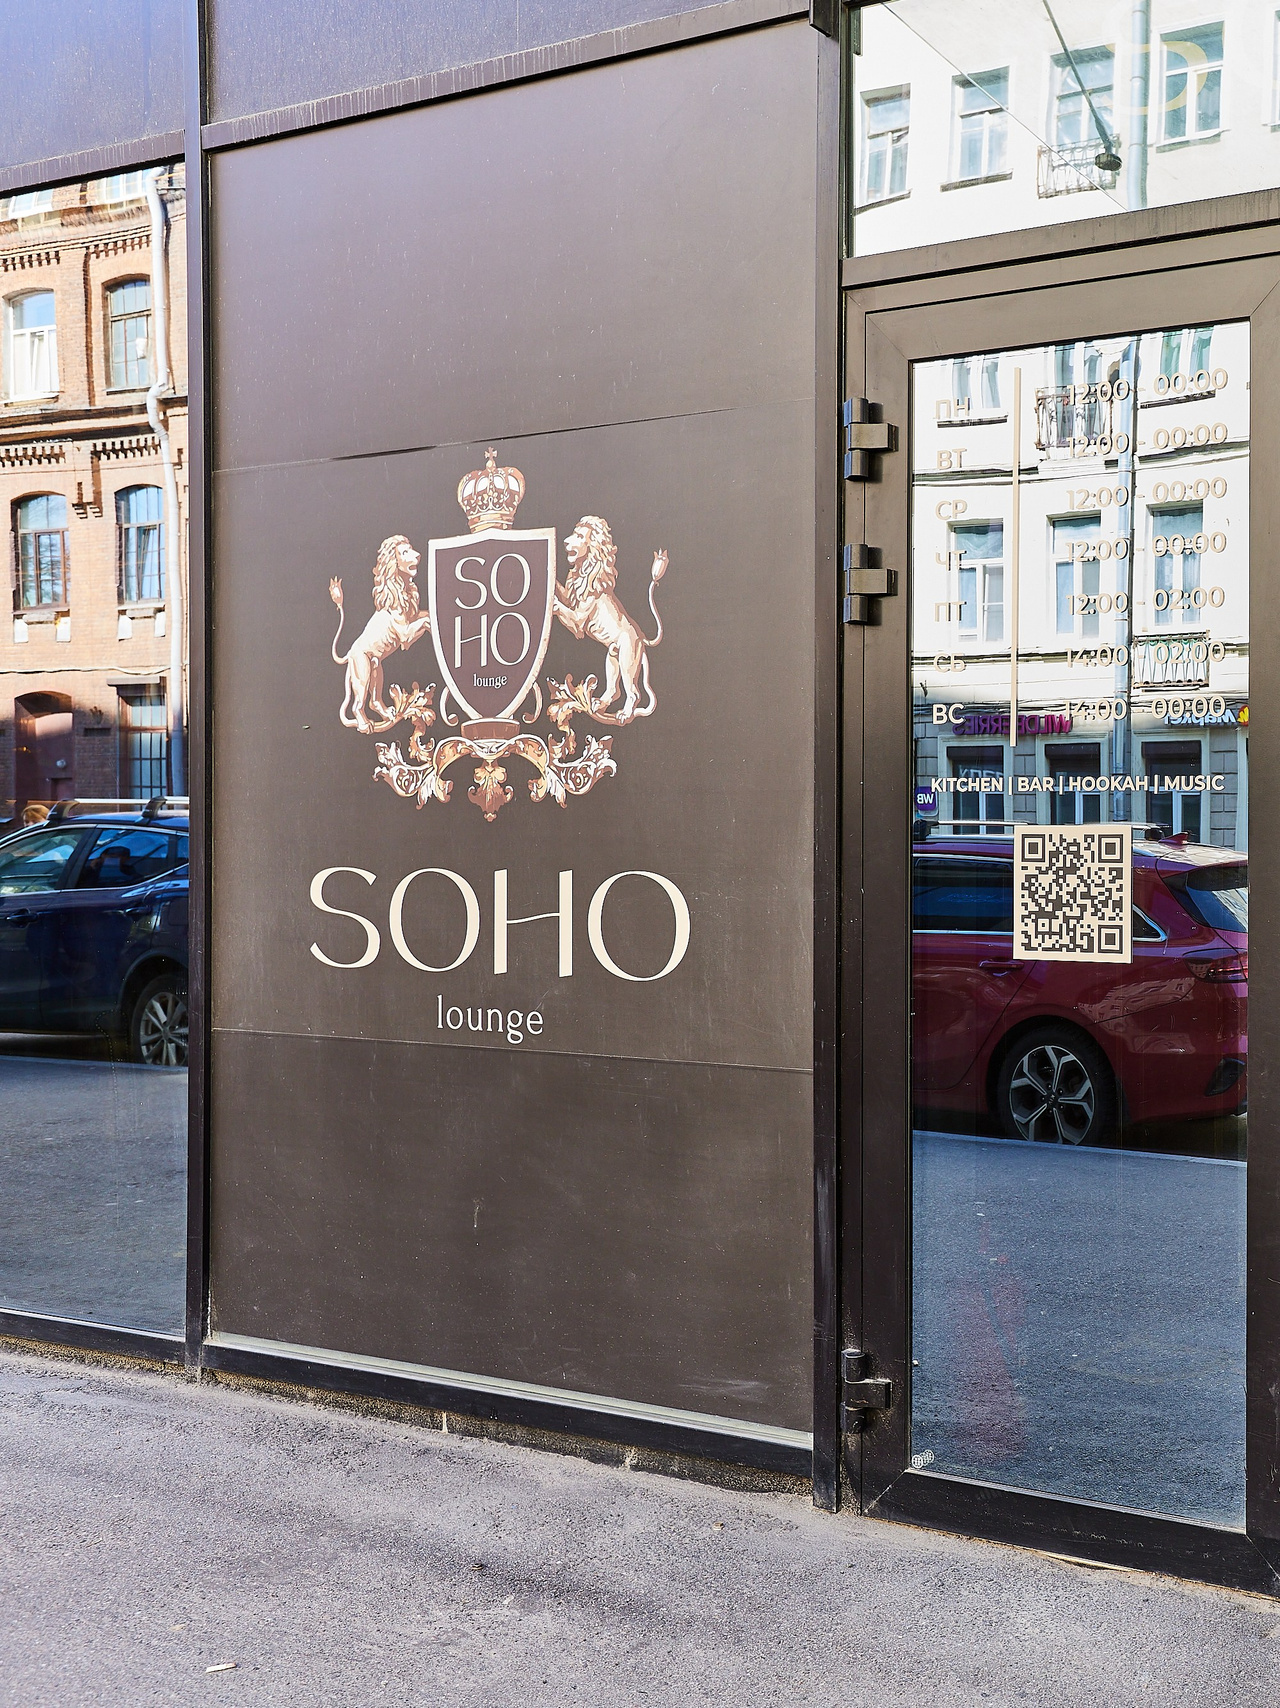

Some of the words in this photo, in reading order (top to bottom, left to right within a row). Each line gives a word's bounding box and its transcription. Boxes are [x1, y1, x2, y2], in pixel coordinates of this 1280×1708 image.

[1066, 379, 1129, 405] 12:00
[1153, 368, 1228, 396] 00:00
[935, 397, 970, 419] ПН
[1066, 433, 1129, 457] 12:00
[1153, 422, 1228, 449] 00:00
[936, 447, 967, 470] ВТ
[1066, 484, 1129, 509] 12:00
[1152, 476, 1228, 502] 00:00
[935, 499, 968, 521] СР
[1065, 537, 1129, 562] 12:00
[1152, 531, 1227, 557] 00:00
[935, 550, 967, 571] ЧТ
[454, 552, 531, 611] SO
[934, 601, 967, 622] ПТ
[1066, 591, 1129, 616] 12:00
[1152, 586, 1226, 611] 02:00
[454, 611, 532, 669] HO
[933, 652, 967, 673] СБ
[1065, 645, 1129, 668] 14:00
[1153, 640, 1226, 666] 02:00
[473, 672, 508, 688] lounge
[932, 703, 965, 725] ВС
[1064, 698, 1127, 721] 14:00
[1151, 695, 1226, 719] 00:00
[931, 777, 1005, 793] KITCHEN
[1017, 777, 1055, 792] BAR
[1068, 775, 1148, 792] HOOKAH
[1164, 774, 1225, 791] MUSIC
[309, 865, 692, 982] SOHO
[436, 994, 545, 1045] lounge
